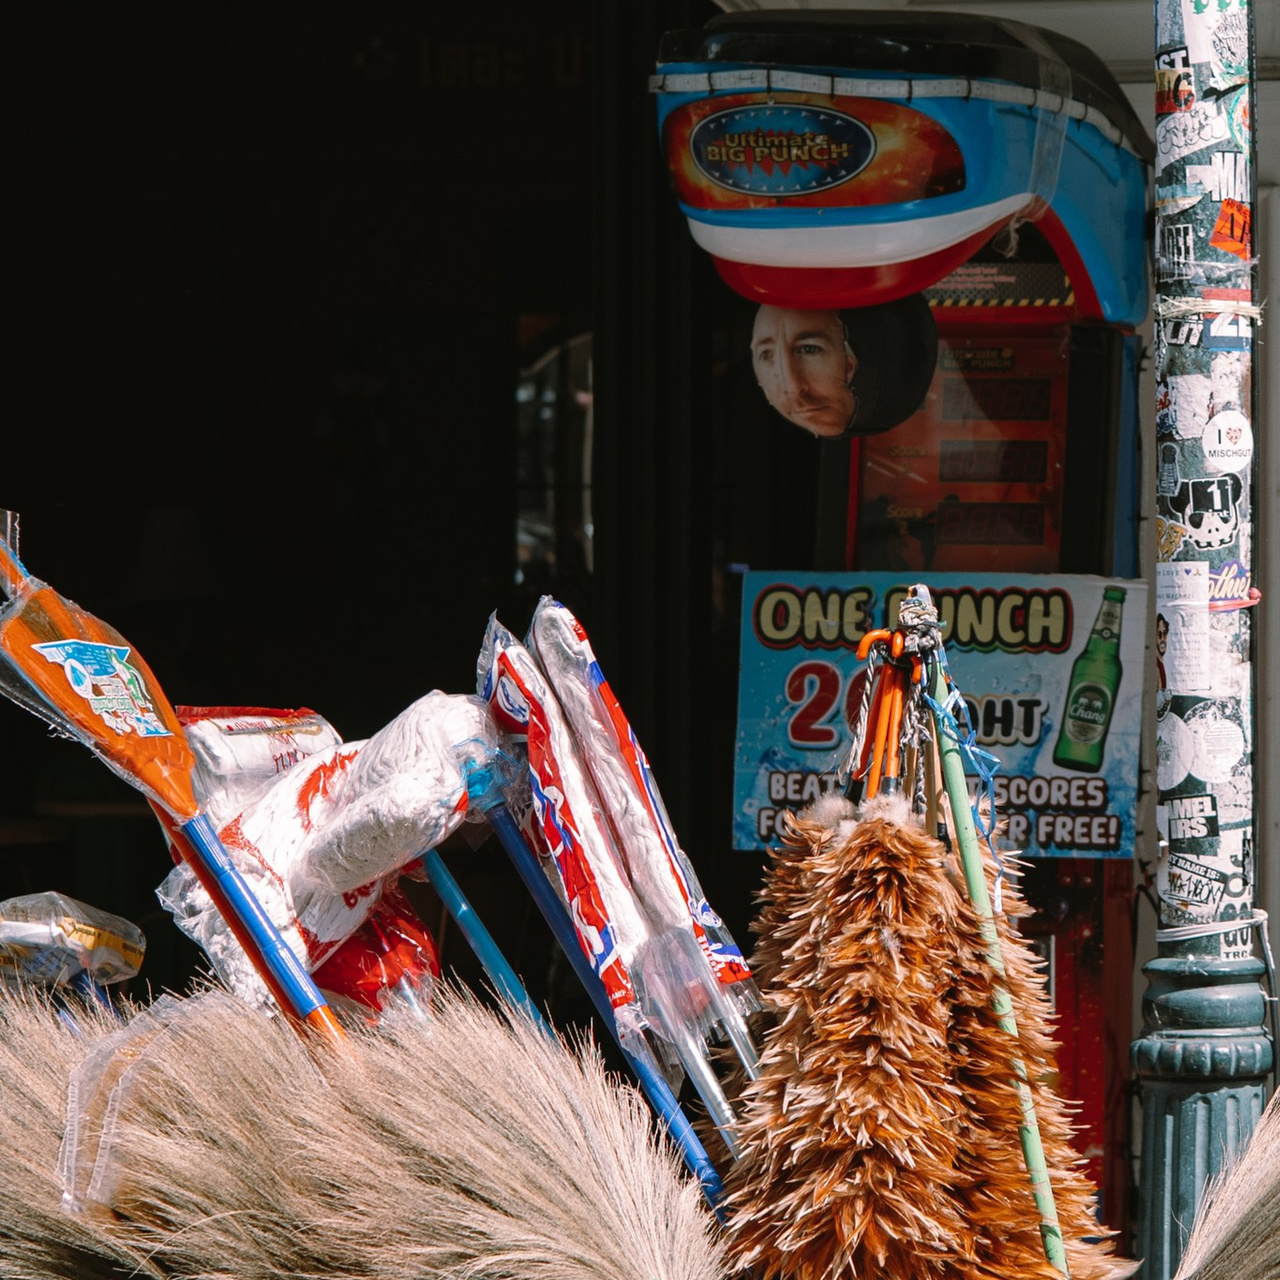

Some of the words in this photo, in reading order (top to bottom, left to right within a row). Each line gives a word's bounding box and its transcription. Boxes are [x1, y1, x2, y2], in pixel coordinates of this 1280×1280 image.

[723, 131, 829, 147] Ultimate
[707, 146, 746, 162] BIG
[754, 143, 849, 162] PUNCH
[1207, 448, 1252, 459] MISCHGUT
[757, 588, 873, 644] ONE
[957, 697, 1044, 742] AHT
[1069, 704, 1106, 724] Chang
[994, 777, 1106, 808] SCORES
[1037, 815, 1119, 845] FREE!
[1177, 859, 1205, 876] NAME
